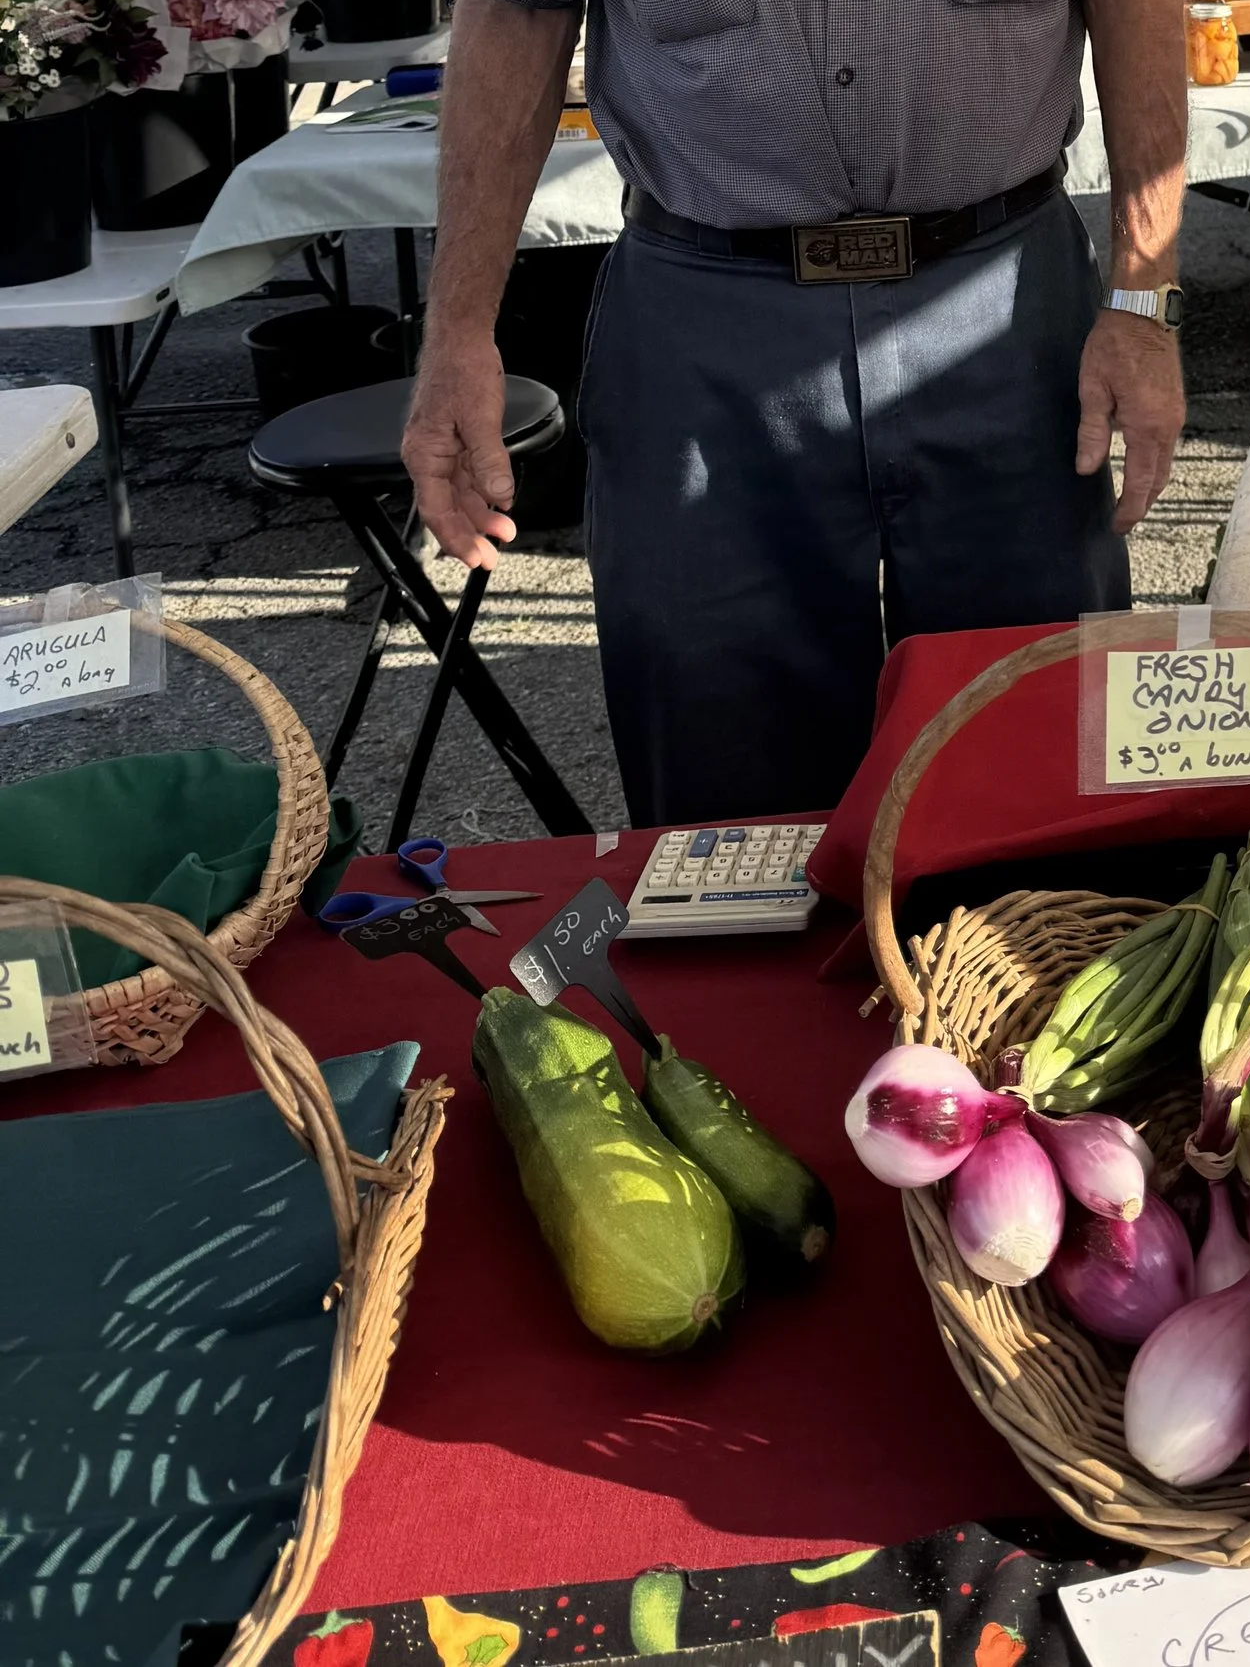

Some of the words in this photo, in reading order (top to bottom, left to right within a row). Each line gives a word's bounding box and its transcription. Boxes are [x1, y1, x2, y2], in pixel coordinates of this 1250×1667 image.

[838, 233, 895, 250] RED
[839, 248, 898, 265] MAN
[3, 626, 106, 666] ARUGULA
[1136, 652, 1235, 683] FRESH
[1132, 680, 1247, 712] CANDY
